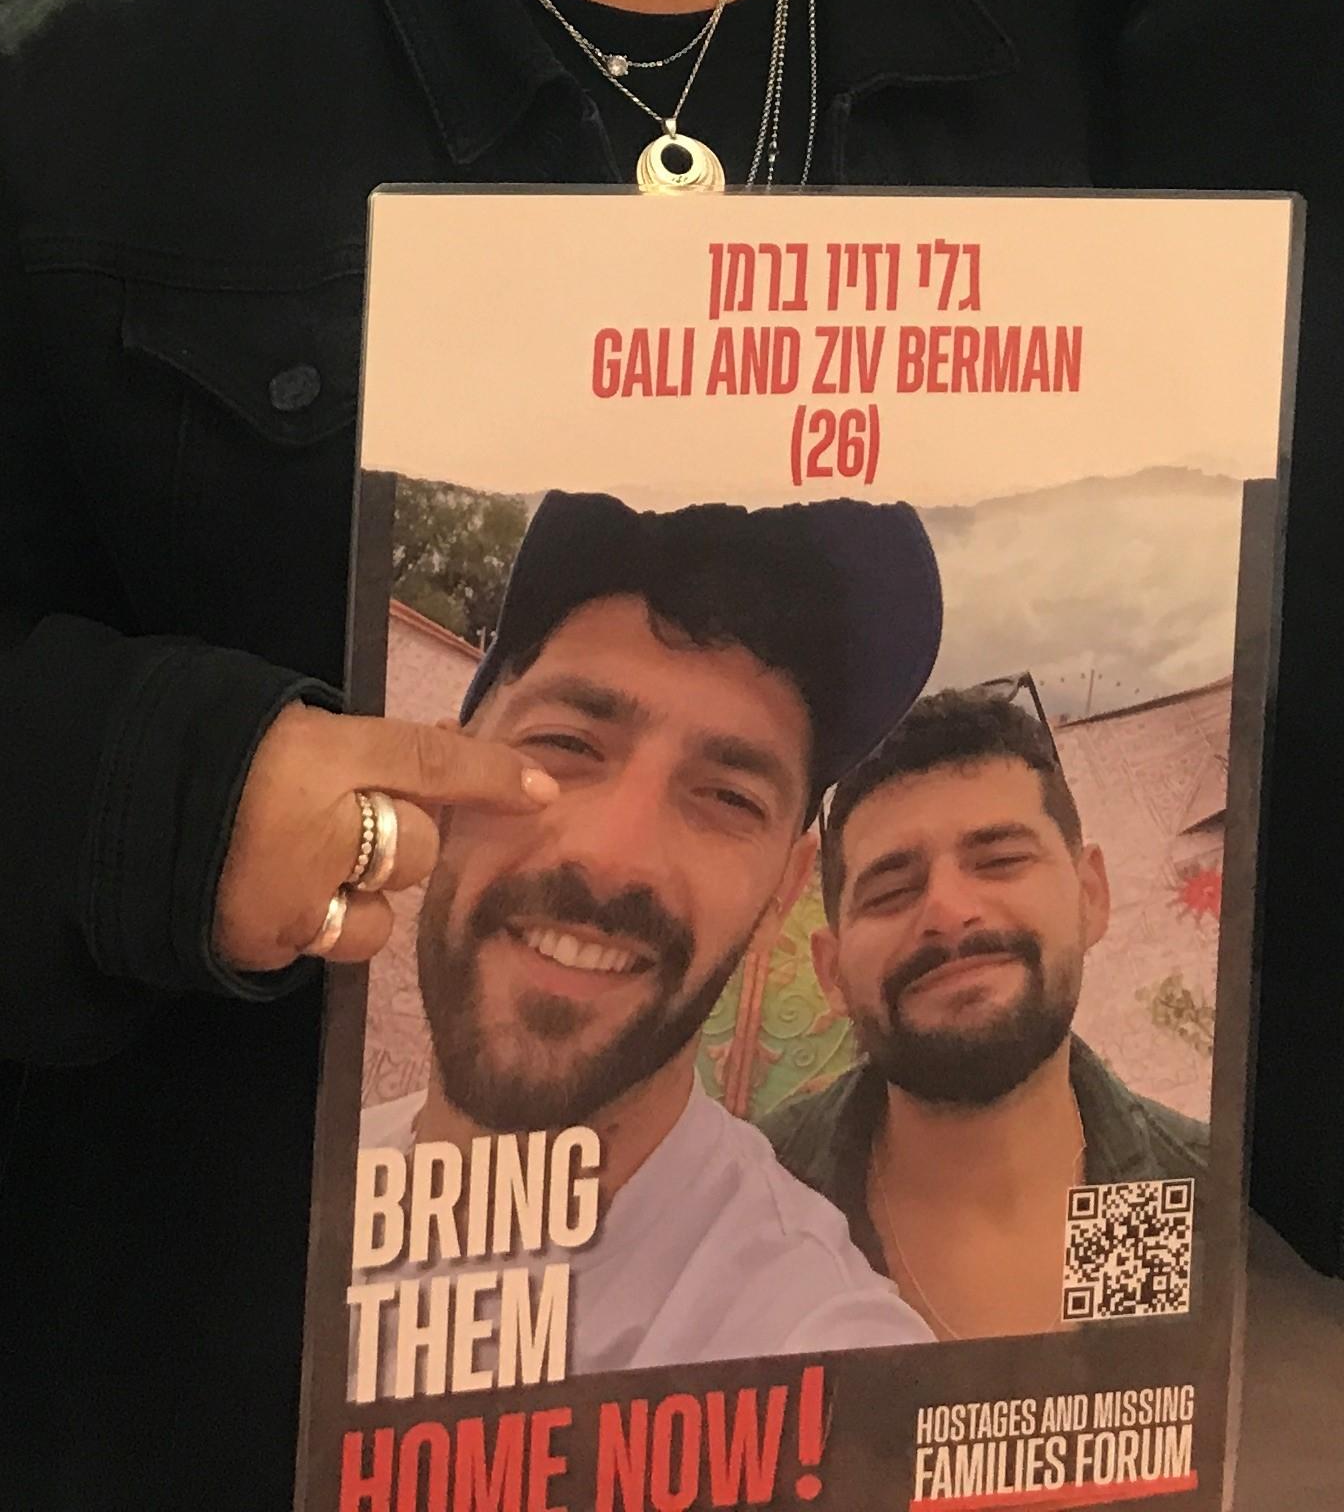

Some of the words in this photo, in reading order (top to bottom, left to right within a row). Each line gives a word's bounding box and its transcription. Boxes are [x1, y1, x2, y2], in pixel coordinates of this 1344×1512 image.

[708, 243, 809, 320] ברמן
[826, 243, 898, 311] וזיו
[917, 239, 981, 312] גלי
[592, 328, 695, 399] GALI
[705, 327, 801, 397] AND
[811, 326, 885, 395] ZIV
[896, 325, 1083, 393] BERMAN
[790, 404, 880, 487] (26)
[353, 1126, 600, 1272] BRING
[347, 1263, 570, 1404] THEM
[340, 1407, 574, 1512] HOME
[595, 1367, 824, 1512] NOW!
[916, 1398, 1037, 1445] HOSTAGES
[1041, 1394, 1088, 1434] AND
[1093, 1384, 1195, 1429] MISSING
[914, 1435, 1068, 1501] FAMILIES
[1075, 1424, 1193, 1487] FORUM
